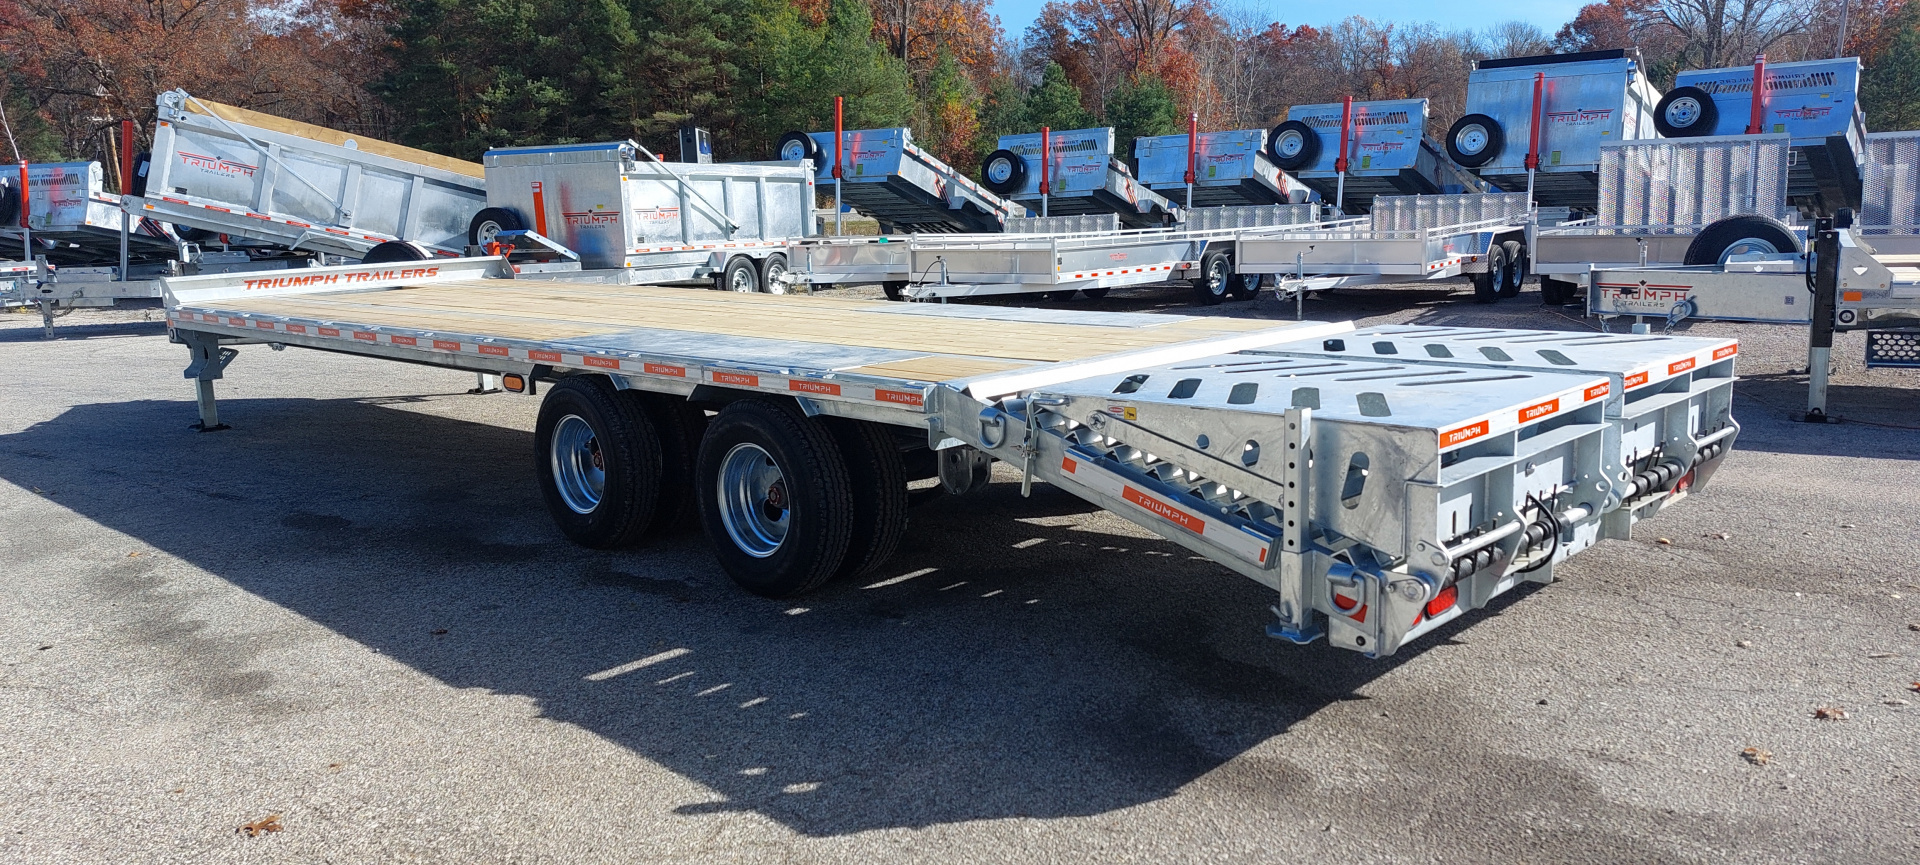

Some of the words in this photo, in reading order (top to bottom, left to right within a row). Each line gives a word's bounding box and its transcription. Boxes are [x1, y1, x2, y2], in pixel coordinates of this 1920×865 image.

[1550, 114, 1610, 122] TRIUMPH
[1777, 110, 1829, 119] TRIUMPH
[181, 157, 254, 177] TRIUMPH
[200, 168, 236, 178] TRAILERS
[565, 215, 618, 224] TRIUMPH
[636, 211, 678, 220] TRIUMPH
[244, 274, 339, 290] TRIUMPH
[344, 267, 440, 282] TRAILERS
[534, 352, 556, 360] TRIUMPH
[590, 358, 613, 366] TRIUMPH
[1673, 360, 1692, 372] TRIUMPH
[652, 366, 678, 375] TRIUMPH
[721, 376, 750, 384] TRIUMPH
[798, 383, 831, 393] TRIUMPH
[886, 393, 923, 404] TRIUMPH
[1526, 403, 1553, 419] TRIUMPH
[1449, 425, 1481, 443] TRIUMPH
[1138, 495, 1189, 525] TRIUMPH
